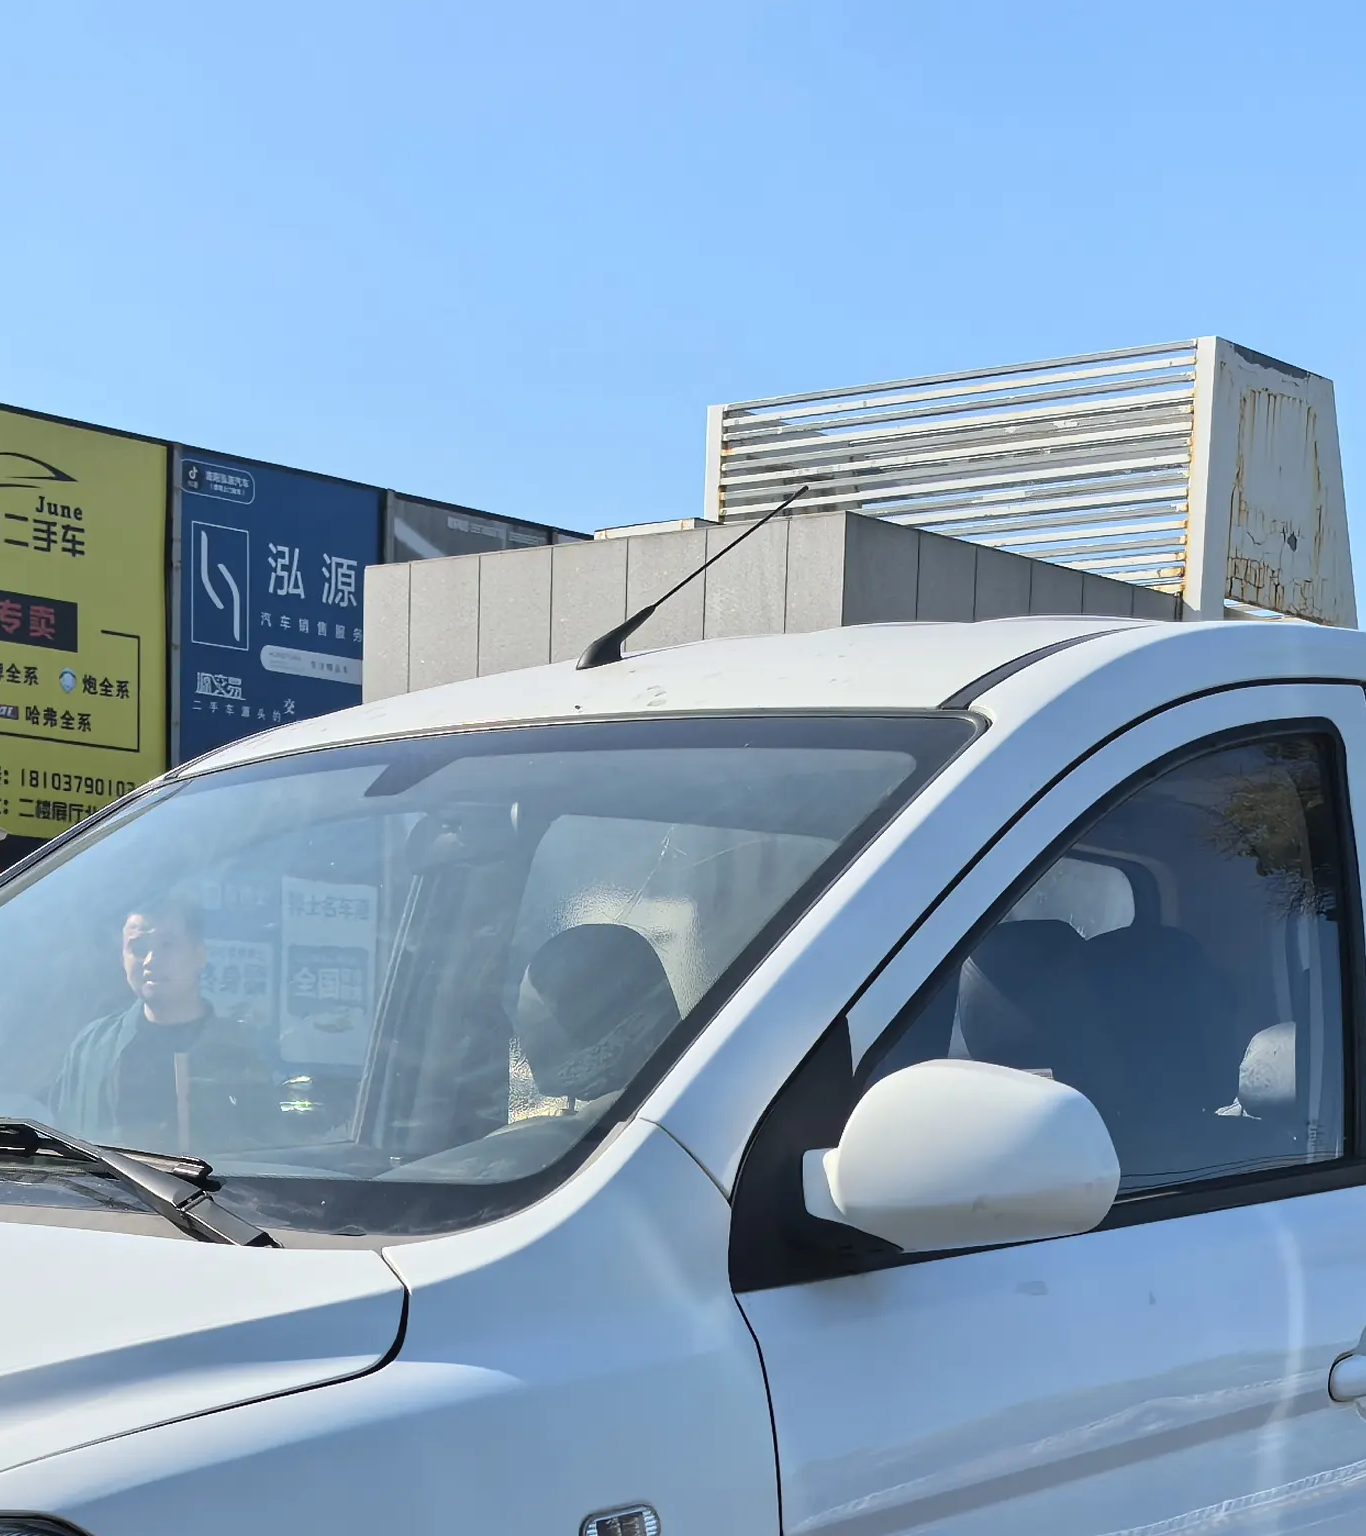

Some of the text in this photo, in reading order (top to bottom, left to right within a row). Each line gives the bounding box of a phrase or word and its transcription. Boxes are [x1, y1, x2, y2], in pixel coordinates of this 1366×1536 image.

[36, 496, 83, 520] June
[267, 542, 358, 607] 泓源
[260, 611, 363, 642] 汽车销售服务
[82, 674, 130, 699] 炮全系
[25, 705, 92, 732] 哈弗全系
